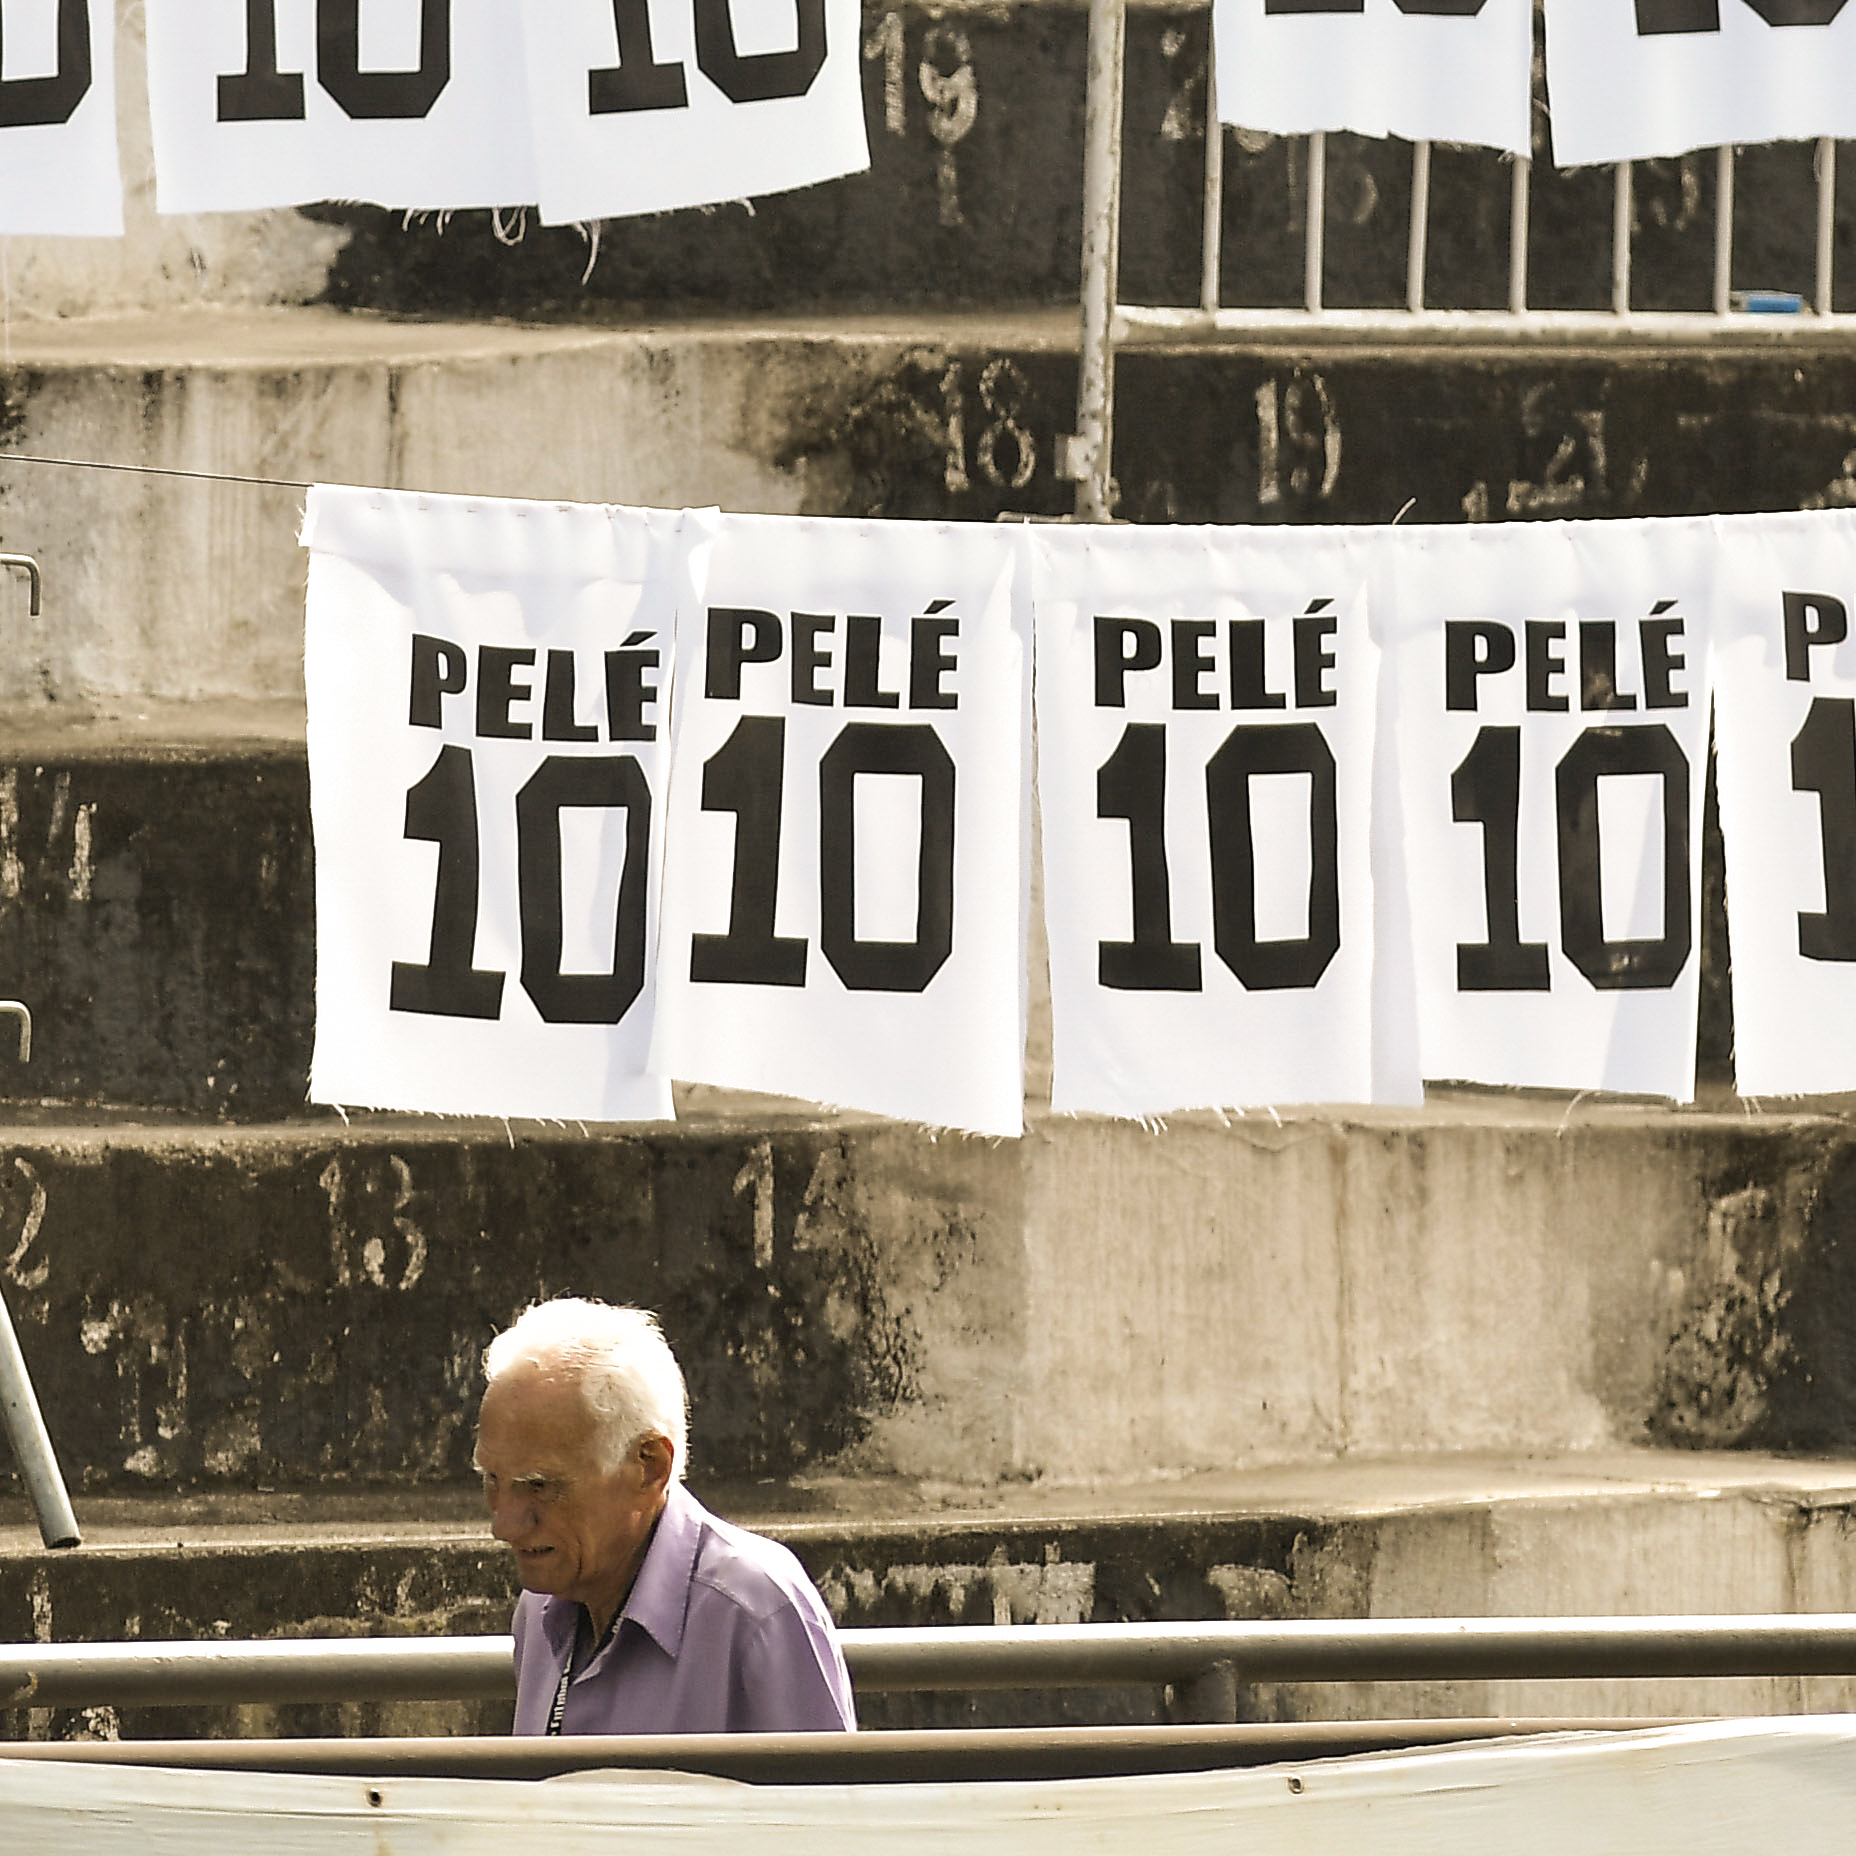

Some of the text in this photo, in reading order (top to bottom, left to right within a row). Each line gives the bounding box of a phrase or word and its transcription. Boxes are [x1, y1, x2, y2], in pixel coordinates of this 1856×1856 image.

[407, 630, 661, 744] PELÉ
[703, 599, 962, 712] PELÉ
[1091, 596, 1340, 712] PELÉ
[1442, 599, 1691, 714] PELÉ
[388, 743, 654, 1026] 10
[687, 712, 958, 993] 10
[1094, 720, 1342, 993] 10
[1449, 721, 1693, 994] 10
[319, 1156, 430, 1292] 13
